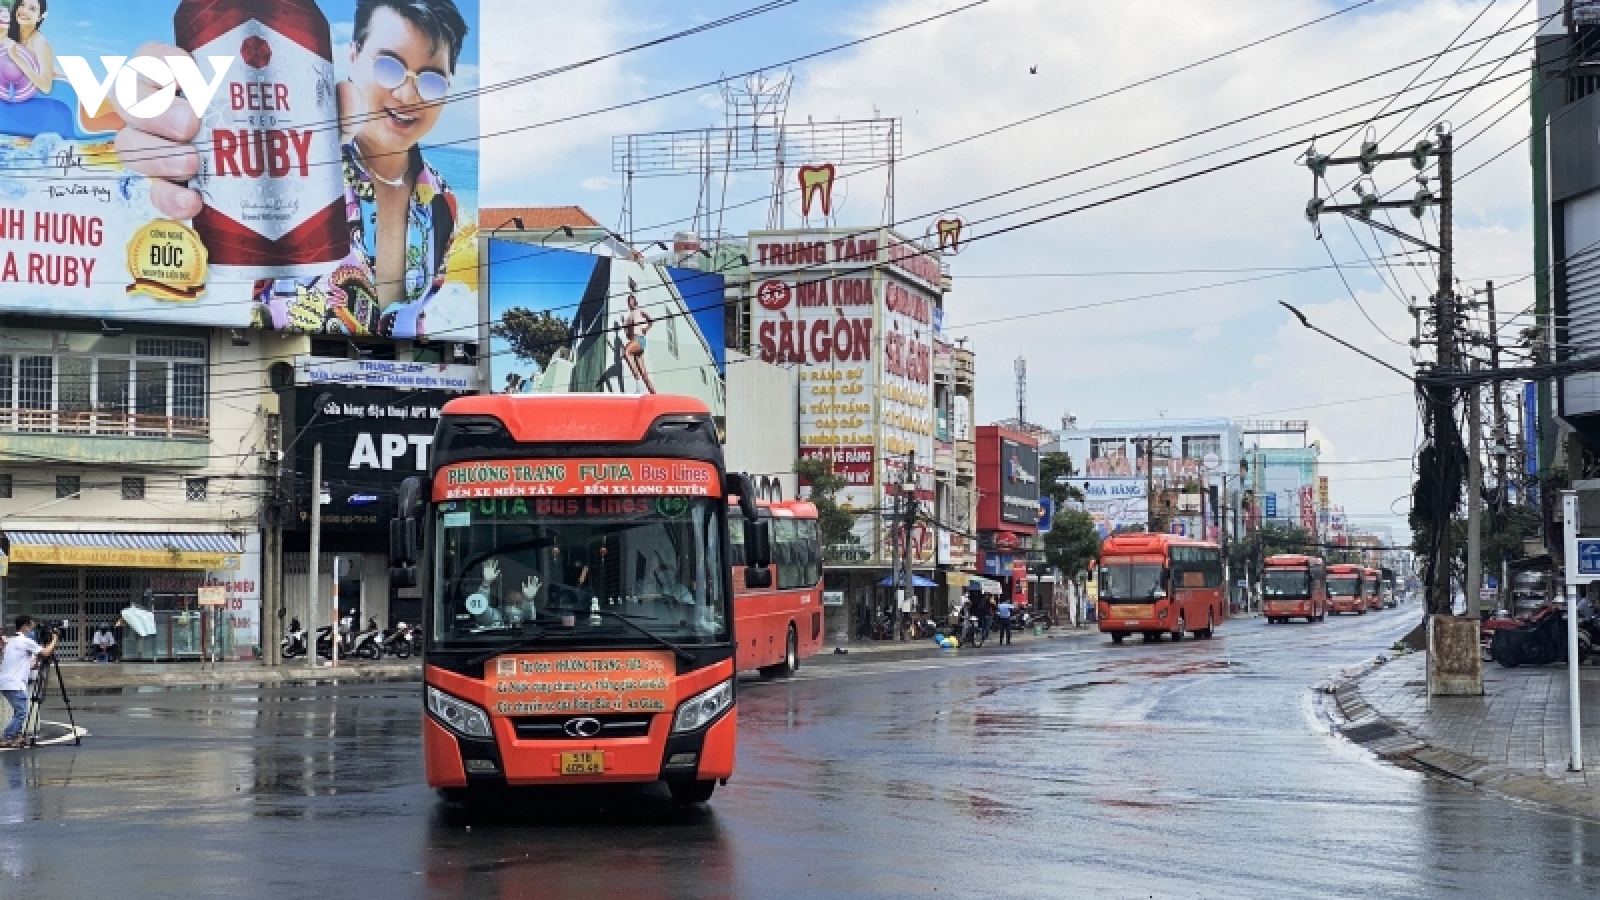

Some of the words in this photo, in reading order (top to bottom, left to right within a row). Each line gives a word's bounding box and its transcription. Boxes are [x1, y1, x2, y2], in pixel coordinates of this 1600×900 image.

[229, 81, 291, 111] BEER
[212, 129, 313, 179] RUBY
[757, 241, 827, 266] TRUNG
[831, 236, 877, 262] TÂM
[27, 252, 97, 288] RUBY
[795, 281, 829, 307] NHA
[831, 278, 874, 305] KHOA
[759, 310, 807, 364] SÀI
[810, 307, 873, 363] GÒN
[347, 431, 435, 471] APT
[447, 463, 510, 485] PHƯƠNG
[512, 464, 566, 482] TRANG
[578, 464, 634, 482] FUTA
[640, 464, 668, 482] Bus
[672, 464, 709, 482] Lines
